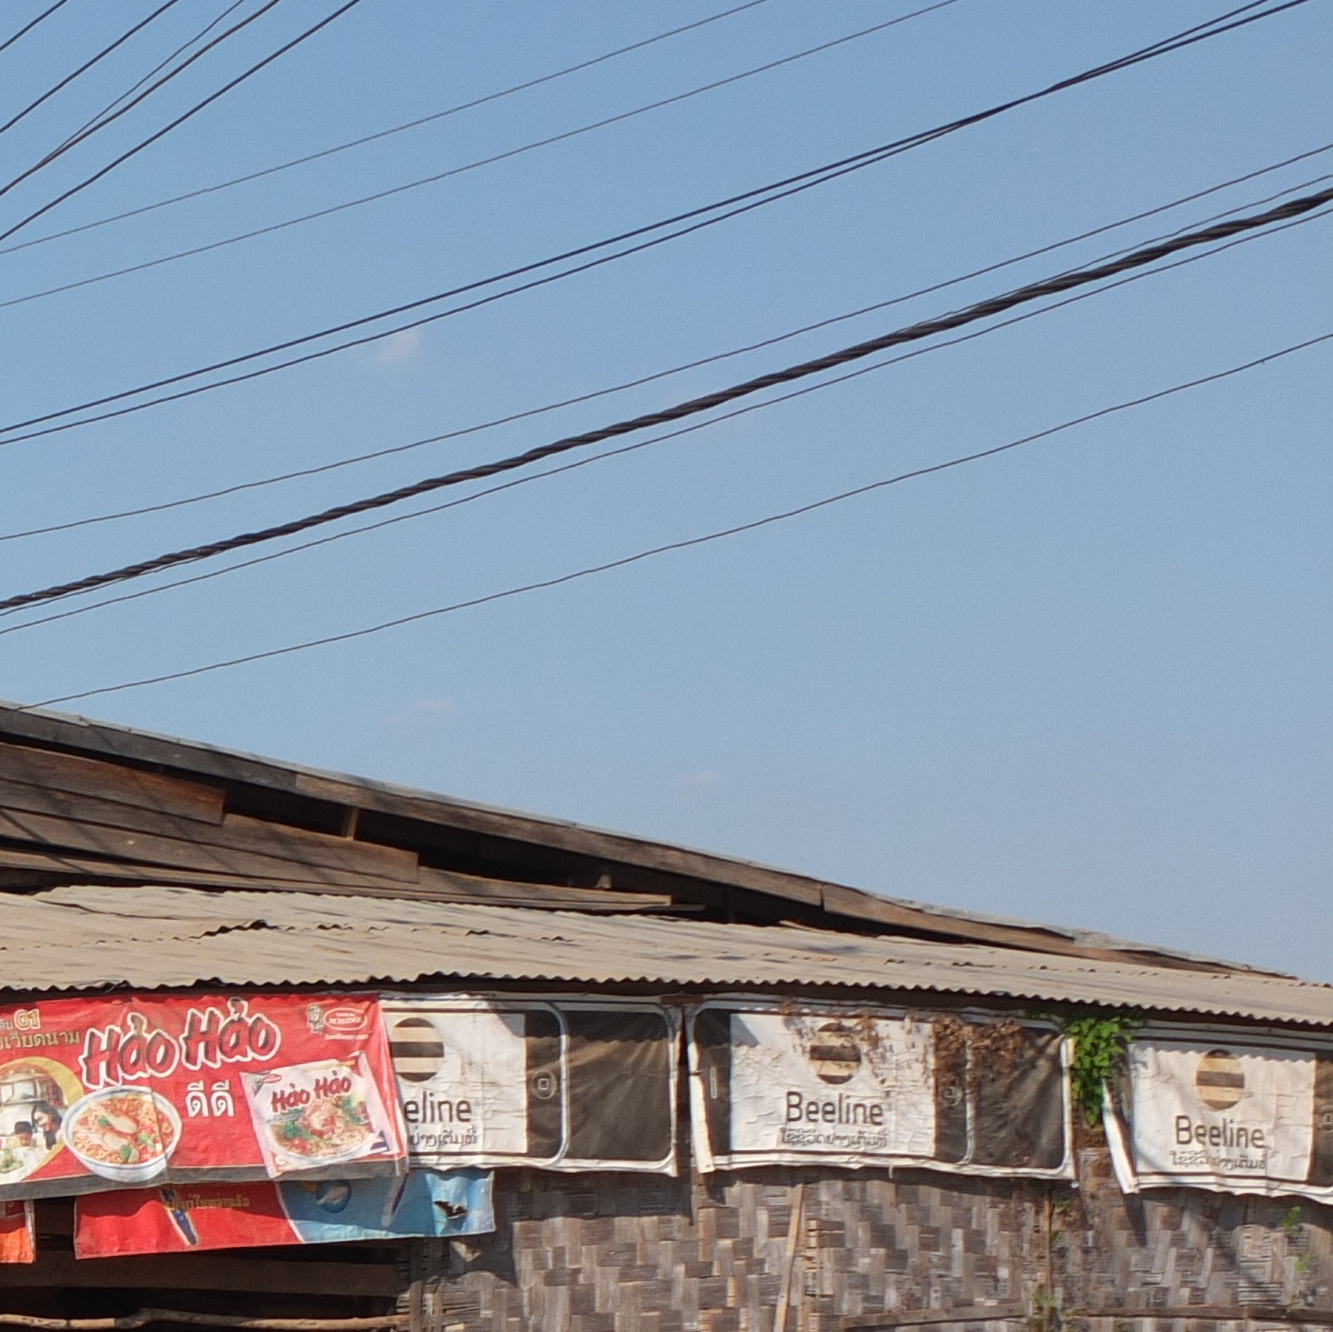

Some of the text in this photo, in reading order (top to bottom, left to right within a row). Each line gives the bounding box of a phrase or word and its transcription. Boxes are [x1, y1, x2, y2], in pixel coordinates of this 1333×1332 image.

[404, 1091, 471, 1123] eline
[786, 1091, 883, 1126] Beeline
[1176, 1115, 1266, 1148] Beeline
